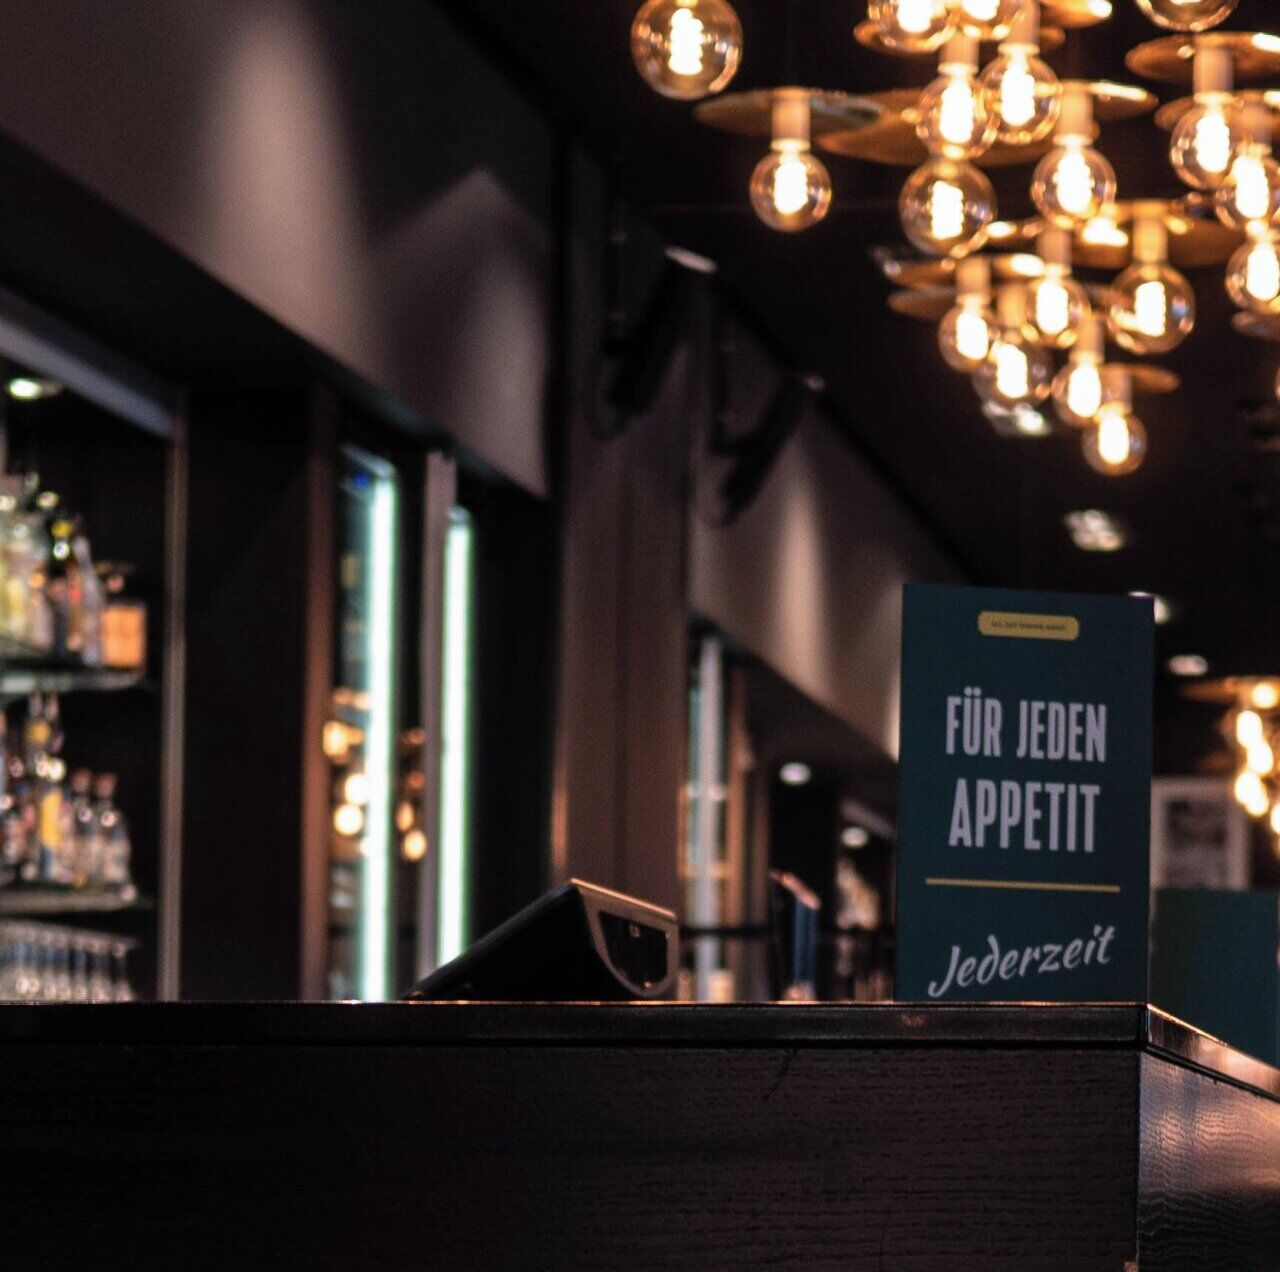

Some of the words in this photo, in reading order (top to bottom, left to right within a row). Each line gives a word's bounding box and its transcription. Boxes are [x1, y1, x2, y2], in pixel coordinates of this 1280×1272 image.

[946, 686, 1003, 758] FÜR
[1015, 699, 1107, 763] JEDEN
[948, 778, 1100, 852] APPETIT
[928, 924, 1115, 998] Jederzeit
